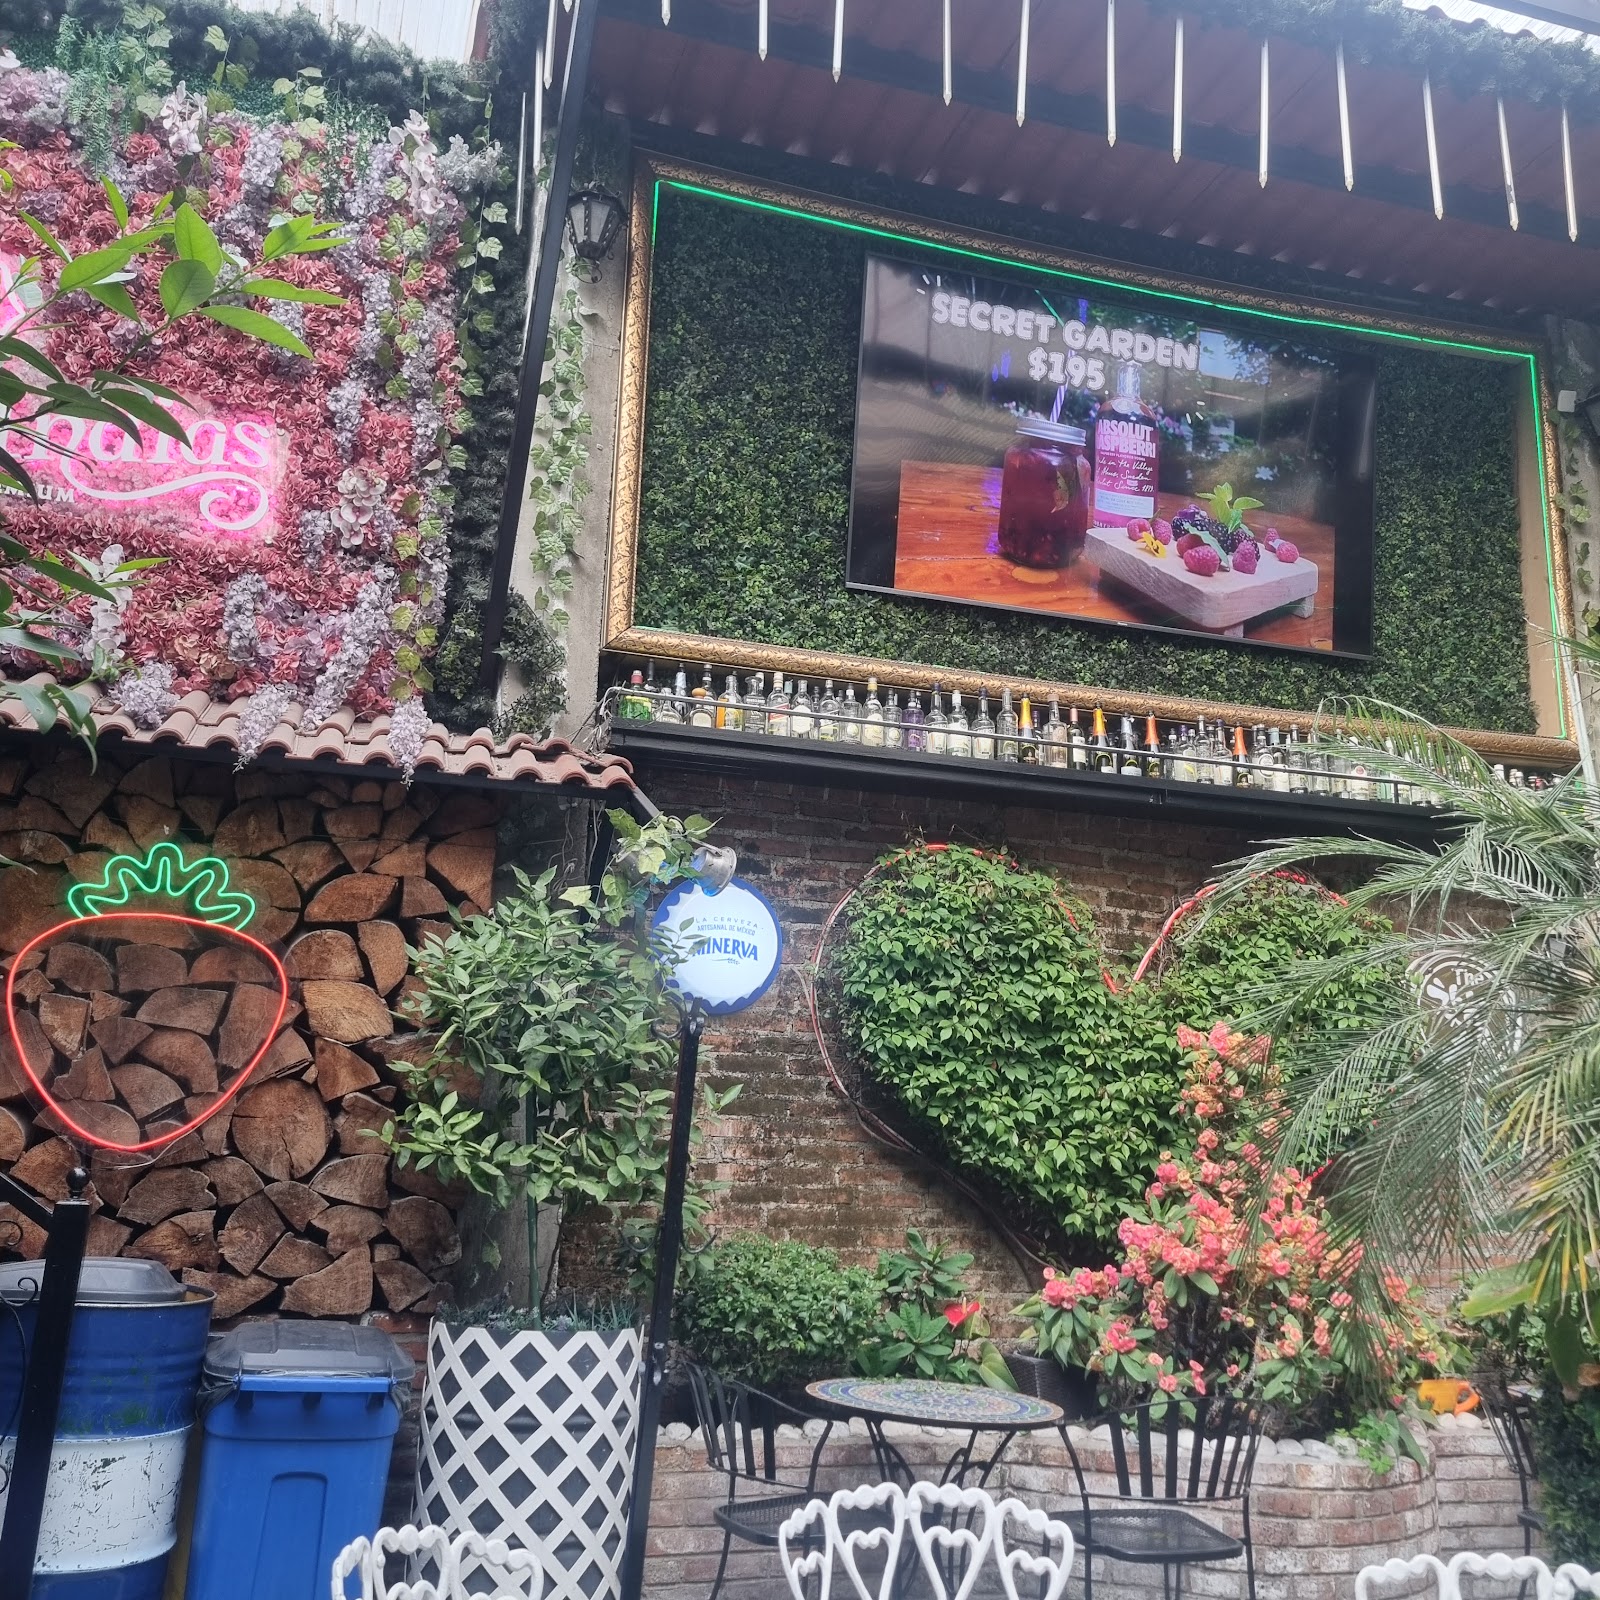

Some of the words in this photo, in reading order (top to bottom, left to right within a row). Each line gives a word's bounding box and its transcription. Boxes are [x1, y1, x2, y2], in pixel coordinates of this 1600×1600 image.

[931, 292, 1056, 344] SECRET
[1062, 319, 1198, 371] GARDEN
[1027, 346, 1106, 390] $195
[1097, 419, 1153, 441] ABSOLUT
[1096, 434, 1156, 459] ASPBERRI
[714, 916, 758, 928] CERVEZA
